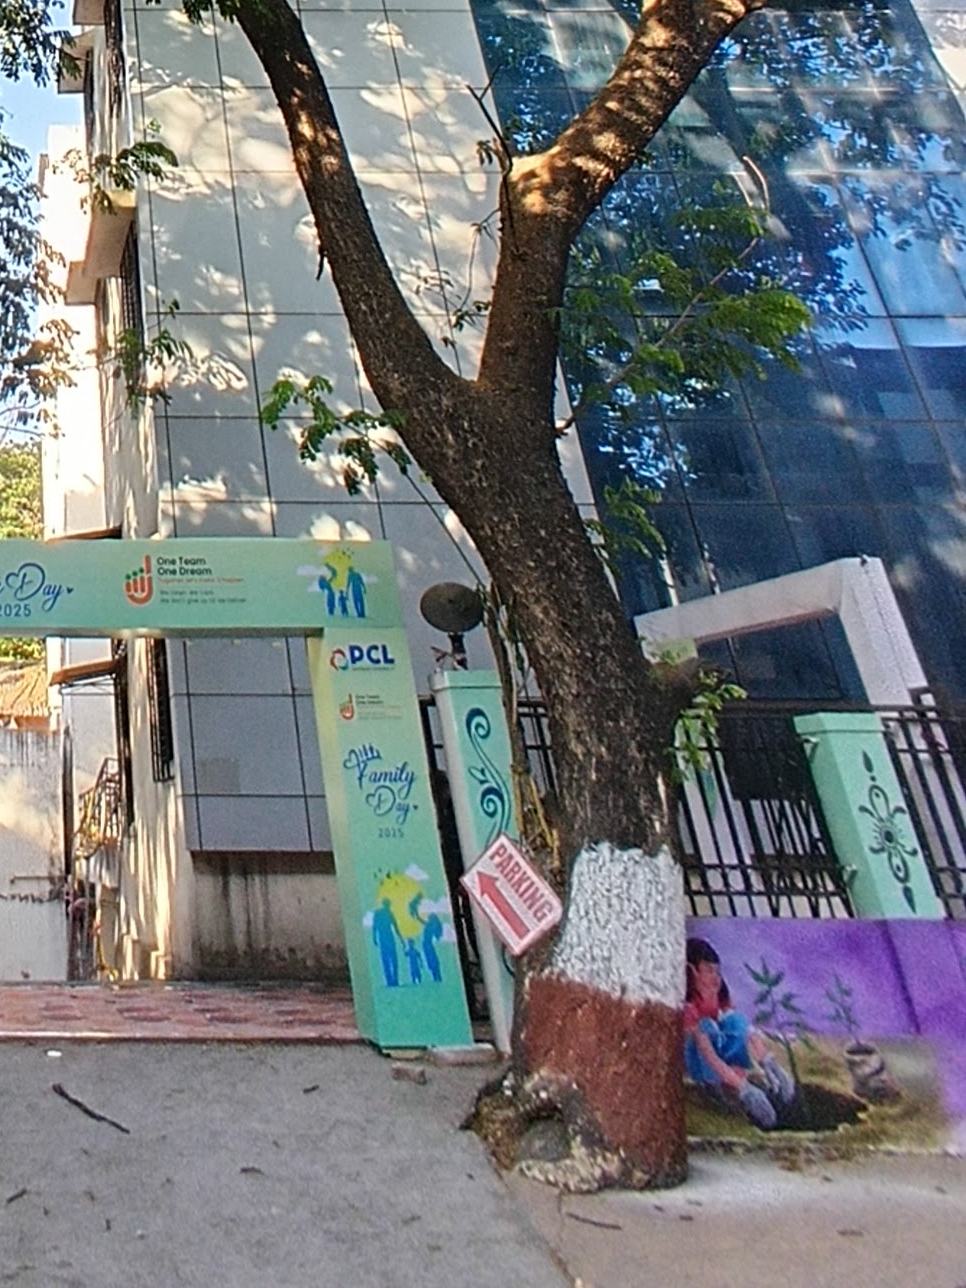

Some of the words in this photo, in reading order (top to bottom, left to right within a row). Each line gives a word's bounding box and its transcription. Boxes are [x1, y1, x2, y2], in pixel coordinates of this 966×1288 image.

[156, 557, 177, 566] One
[178, 556, 207, 566] Team
[157, 567, 177, 576] One
[179, 567, 213, 576] Dream
[5, 562, 64, 613] Day
[348, 643, 396, 665] PCL
[343, 742, 415, 801] Family
[365, 784, 410, 826] Day
[377, 827, 405, 839] 2025
[489, 842, 554, 923] PARKING
